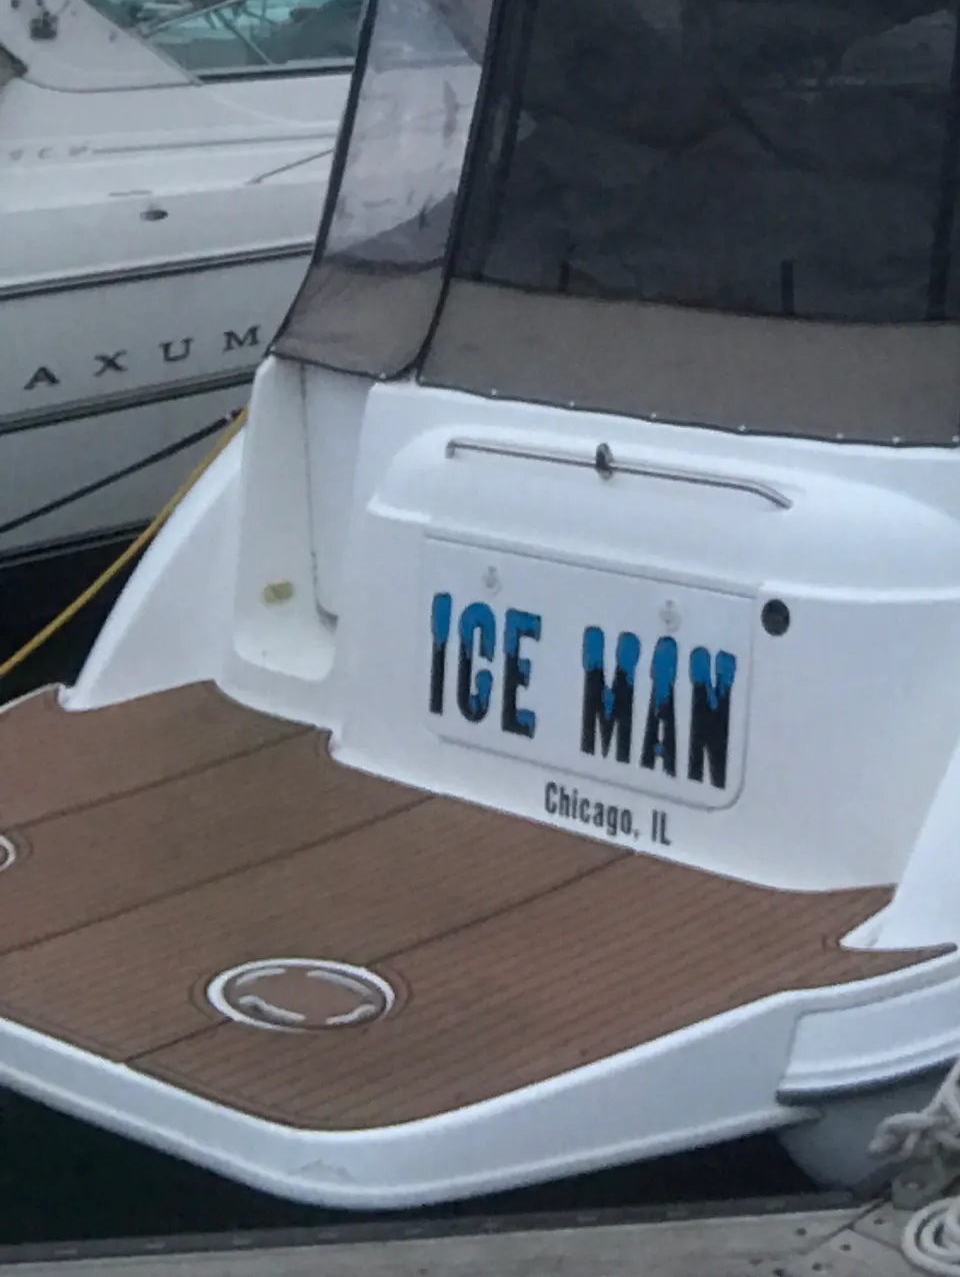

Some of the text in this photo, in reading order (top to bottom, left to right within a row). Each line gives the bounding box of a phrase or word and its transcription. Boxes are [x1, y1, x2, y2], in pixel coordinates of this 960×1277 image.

[23, 325, 261, 391] AXUM
[429, 591, 737, 791] ICE MAN
[544, 780, 671, 847] Chicago, IL
